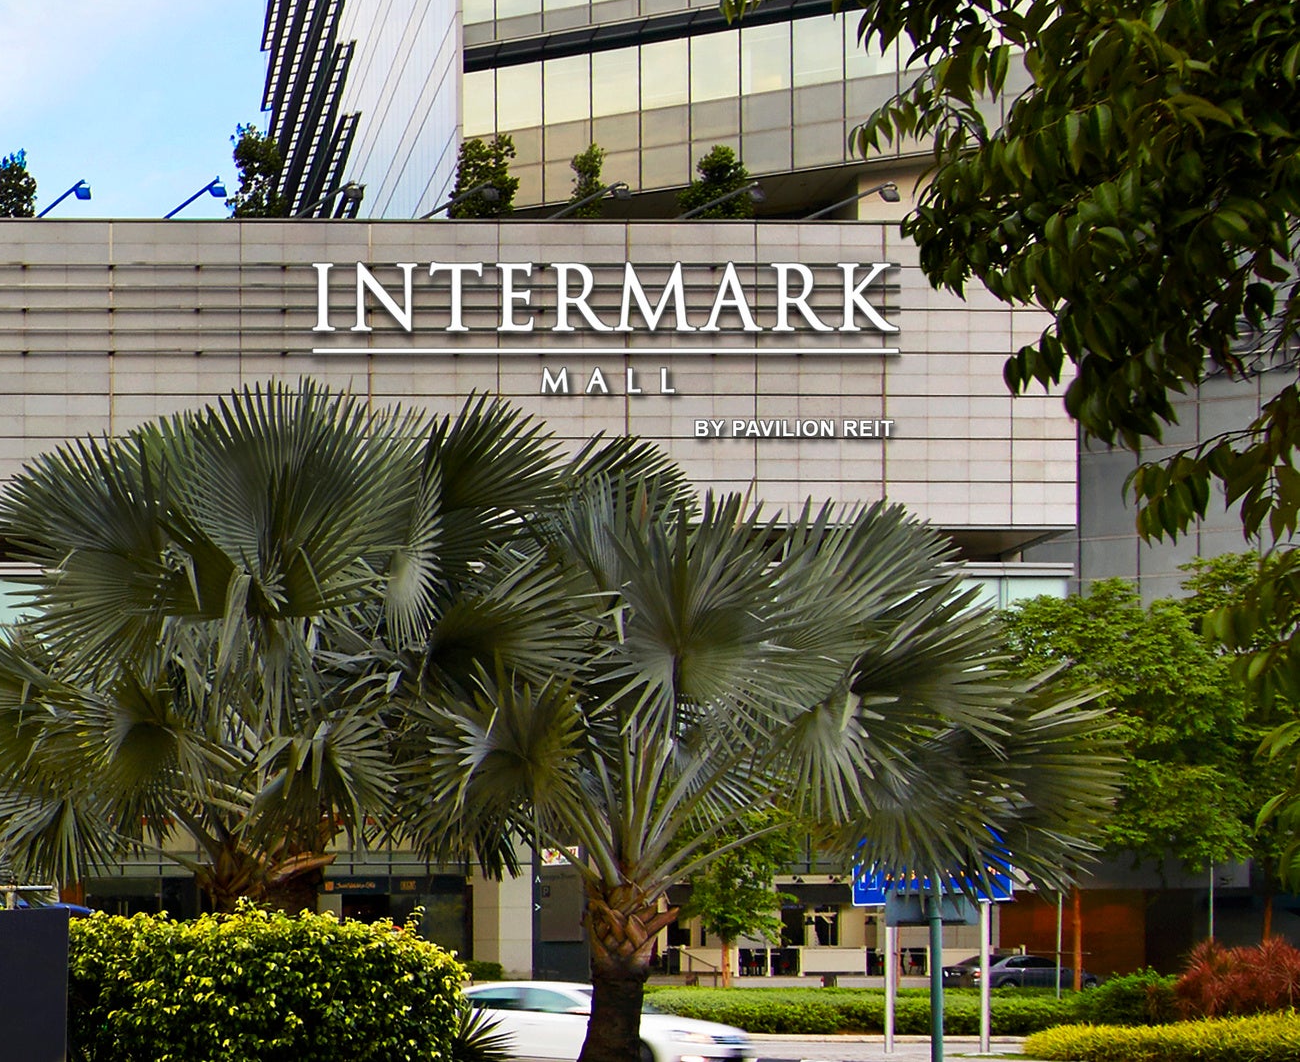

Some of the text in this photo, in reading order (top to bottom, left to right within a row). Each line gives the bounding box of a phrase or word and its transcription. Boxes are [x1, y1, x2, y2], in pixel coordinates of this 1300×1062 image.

[311, 261, 900, 333] INTERMARK
[540, 367, 676, 394] MALL
[694, 419, 895, 438] BY PAVILION REIT
